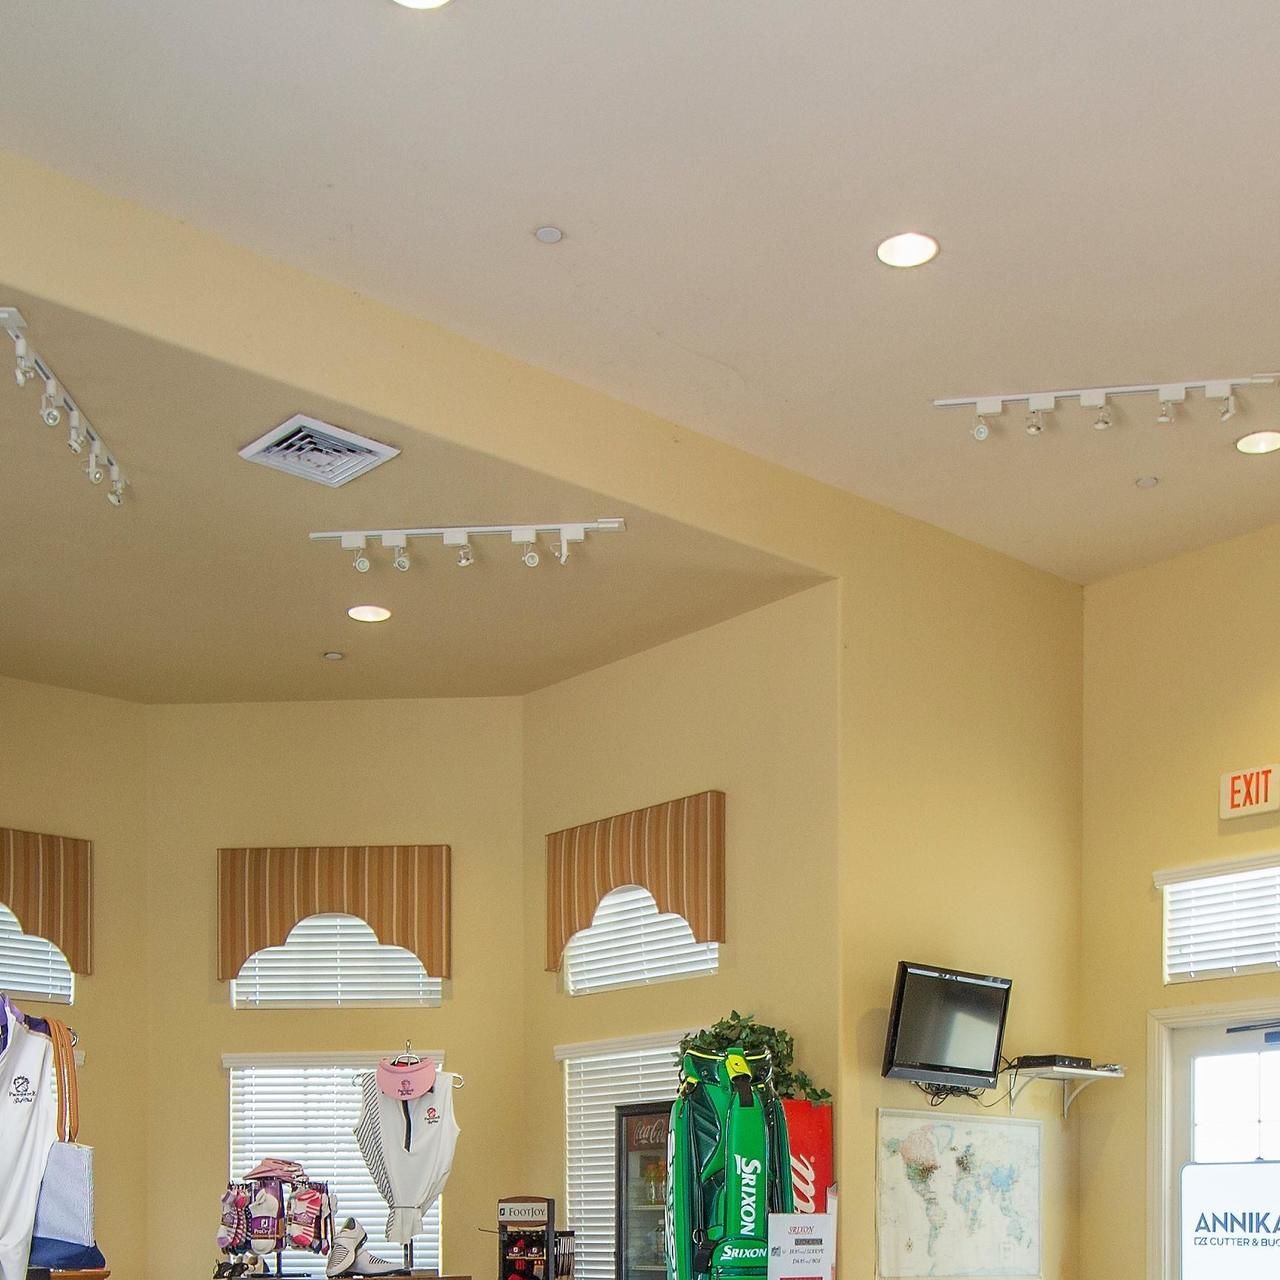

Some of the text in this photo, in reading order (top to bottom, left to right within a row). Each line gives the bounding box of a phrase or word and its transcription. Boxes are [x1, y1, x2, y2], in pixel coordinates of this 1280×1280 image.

[1231, 769, 1272, 809] EXIT
[735, 1153, 761, 1236] SRIXON
[509, 1207, 546, 1217] FOOTJOY
[1210, 1237, 1250, 1247] CUTTER
[1251, 1238, 1259, 1247] &
[720, 1244, 768, 1260] SRIXON
